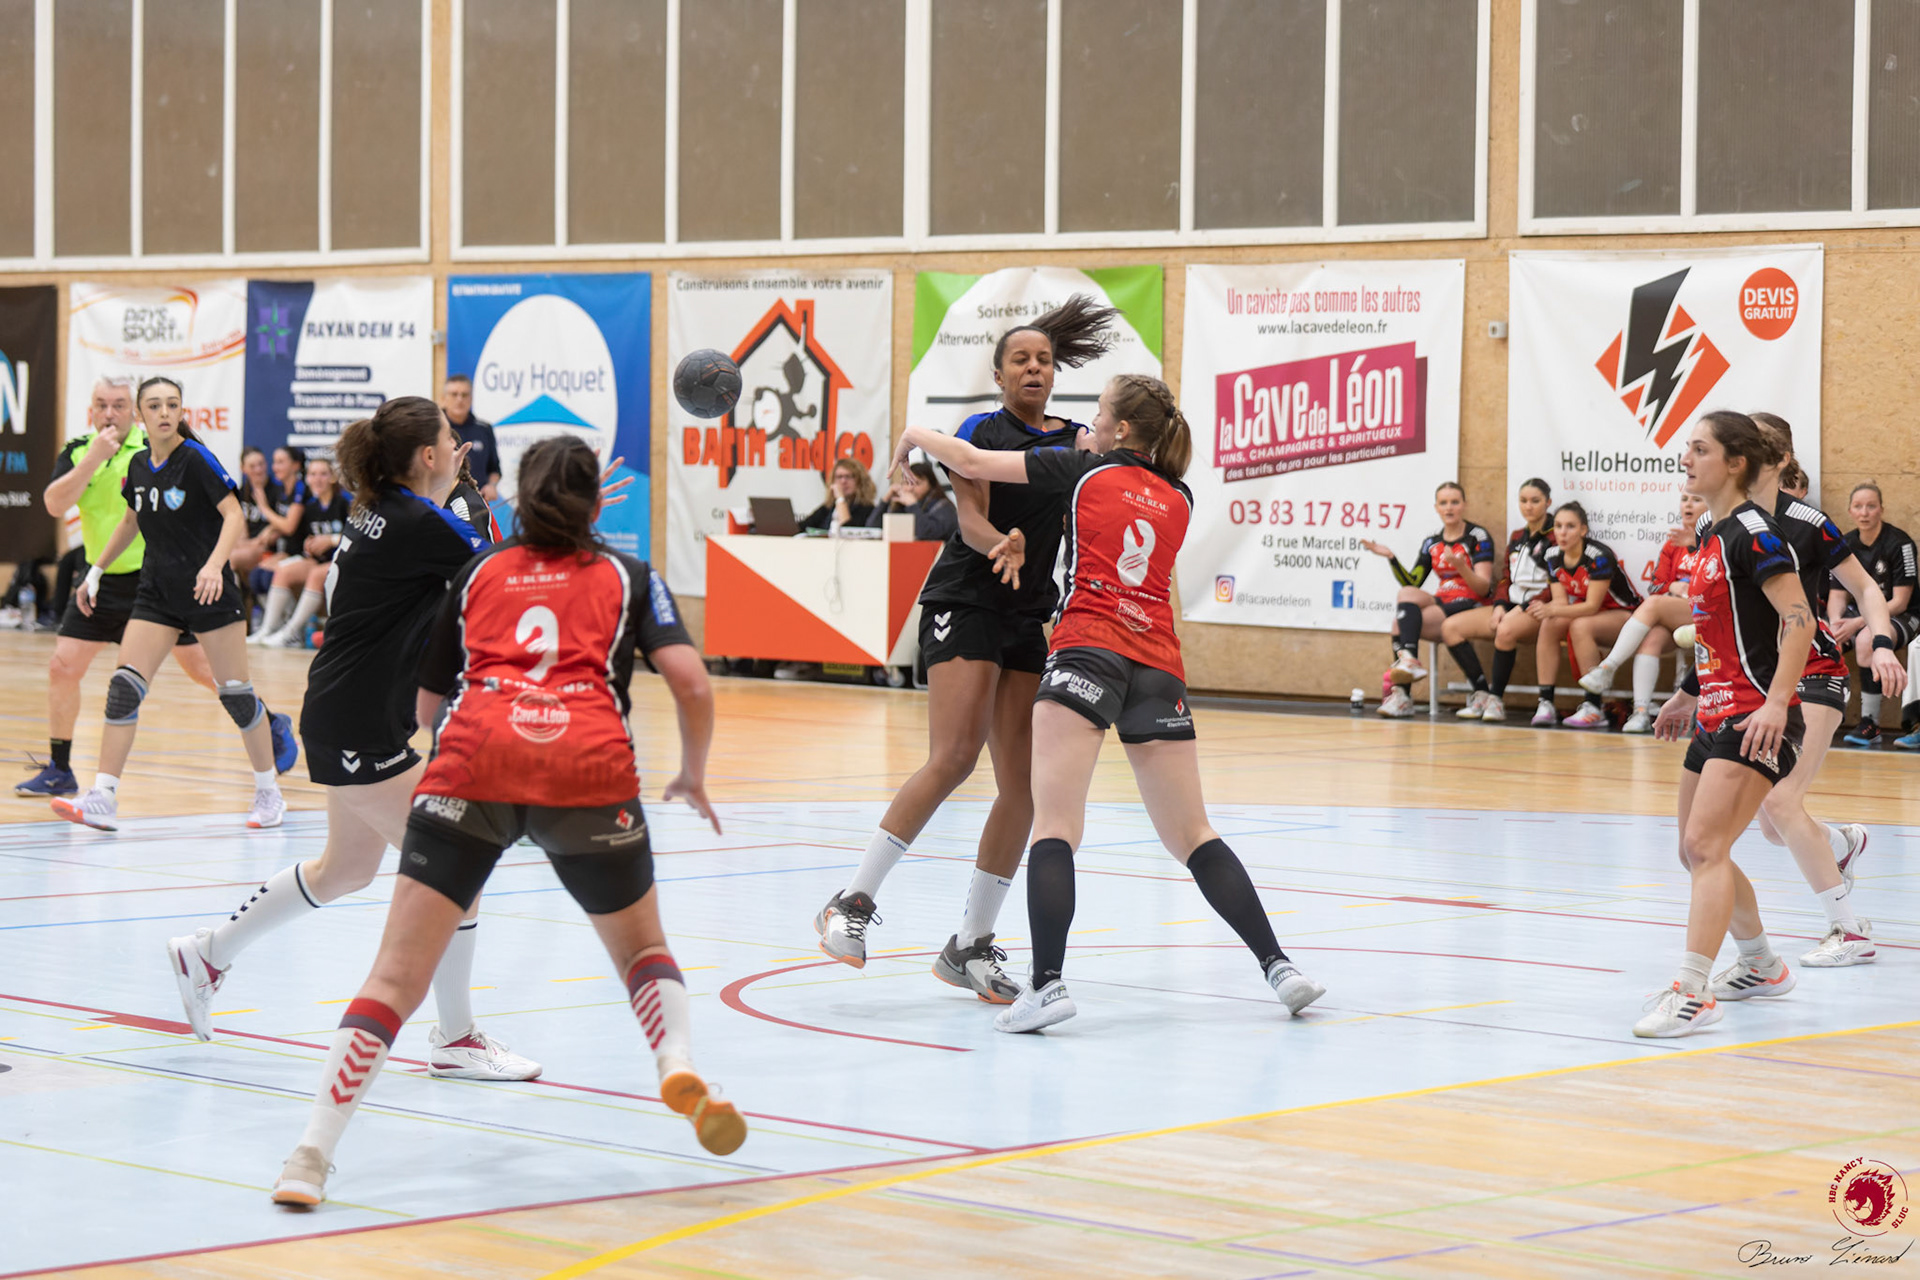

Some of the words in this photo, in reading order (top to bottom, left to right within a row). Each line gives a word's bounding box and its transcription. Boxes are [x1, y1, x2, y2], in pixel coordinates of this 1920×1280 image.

[676, 278, 749, 291] Construisons
[752, 277, 807, 290] ensemble
[812, 279, 842, 290] votre
[846, 277, 884, 290] avenir
[1227, 287, 1243, 314] Un
[1246, 287, 1287, 314] caviste
[1289, 291, 1310, 317] pas
[1314, 290, 1357, 313] comme
[1361, 285, 1379, 313] les
[1382, 285, 1421, 313] autres
[1743, 286, 1796, 306] DEVIS
[977, 302, 1028, 319] Soirées
[1032, 301, 1039, 315] à
[1744, 306, 1794, 320] GRATUIT
[306, 321, 354, 338] RAYAN
[358, 322, 393, 338] DEM
[398, 321, 416, 338] 54
[1257, 319, 1388, 335] www.lacavedeleon.fr
[482, 362, 524, 398] Guy
[530, 363, 605, 397] Hoquet
[1219, 416, 1233, 451] la
[1233, 373, 1309, 450] Cave
[1308, 400, 1328, 438] de
[1328, 353, 1403, 434] Léon
[778, 430, 825, 471] and
[1249, 438, 1325, 460] CHAMPAGNES
[1327, 437, 1336, 448] &
[1338, 426, 1402, 446] SPIRITUEUX
[1226, 465, 1244, 480] des
[1245, 462, 1274, 478] tarifs
[1303, 455, 1326, 470] pour
[1328, 450, 1343, 465] les
[1345, 444, 1396, 464] particuliers
[1563, 478, 1575, 490] La
[1580, 478, 1636, 492] solution
[1641, 481, 1673, 495] pour
[1229, 499, 1262, 525] 03
[1269, 500, 1294, 525] 83
[1303, 501, 1332, 526] 17
[1340, 502, 1371, 528] 84
[1378, 503, 1407, 529] 57
[1607, 511, 1657, 525] générale
[1116, 518, 1156, 587] 8
[1261, 534, 1274, 548] 43
[1277, 537, 1298, 549] rue
[1302, 535, 1345, 550] Marcel
[1273, 554, 1312, 569] 54000
[1315, 555, 1361, 571] NANCY
[515, 605, 559, 683] 9
[1066, 683, 1101, 705] SPORT
[1070, 674, 1104, 698] INTER
